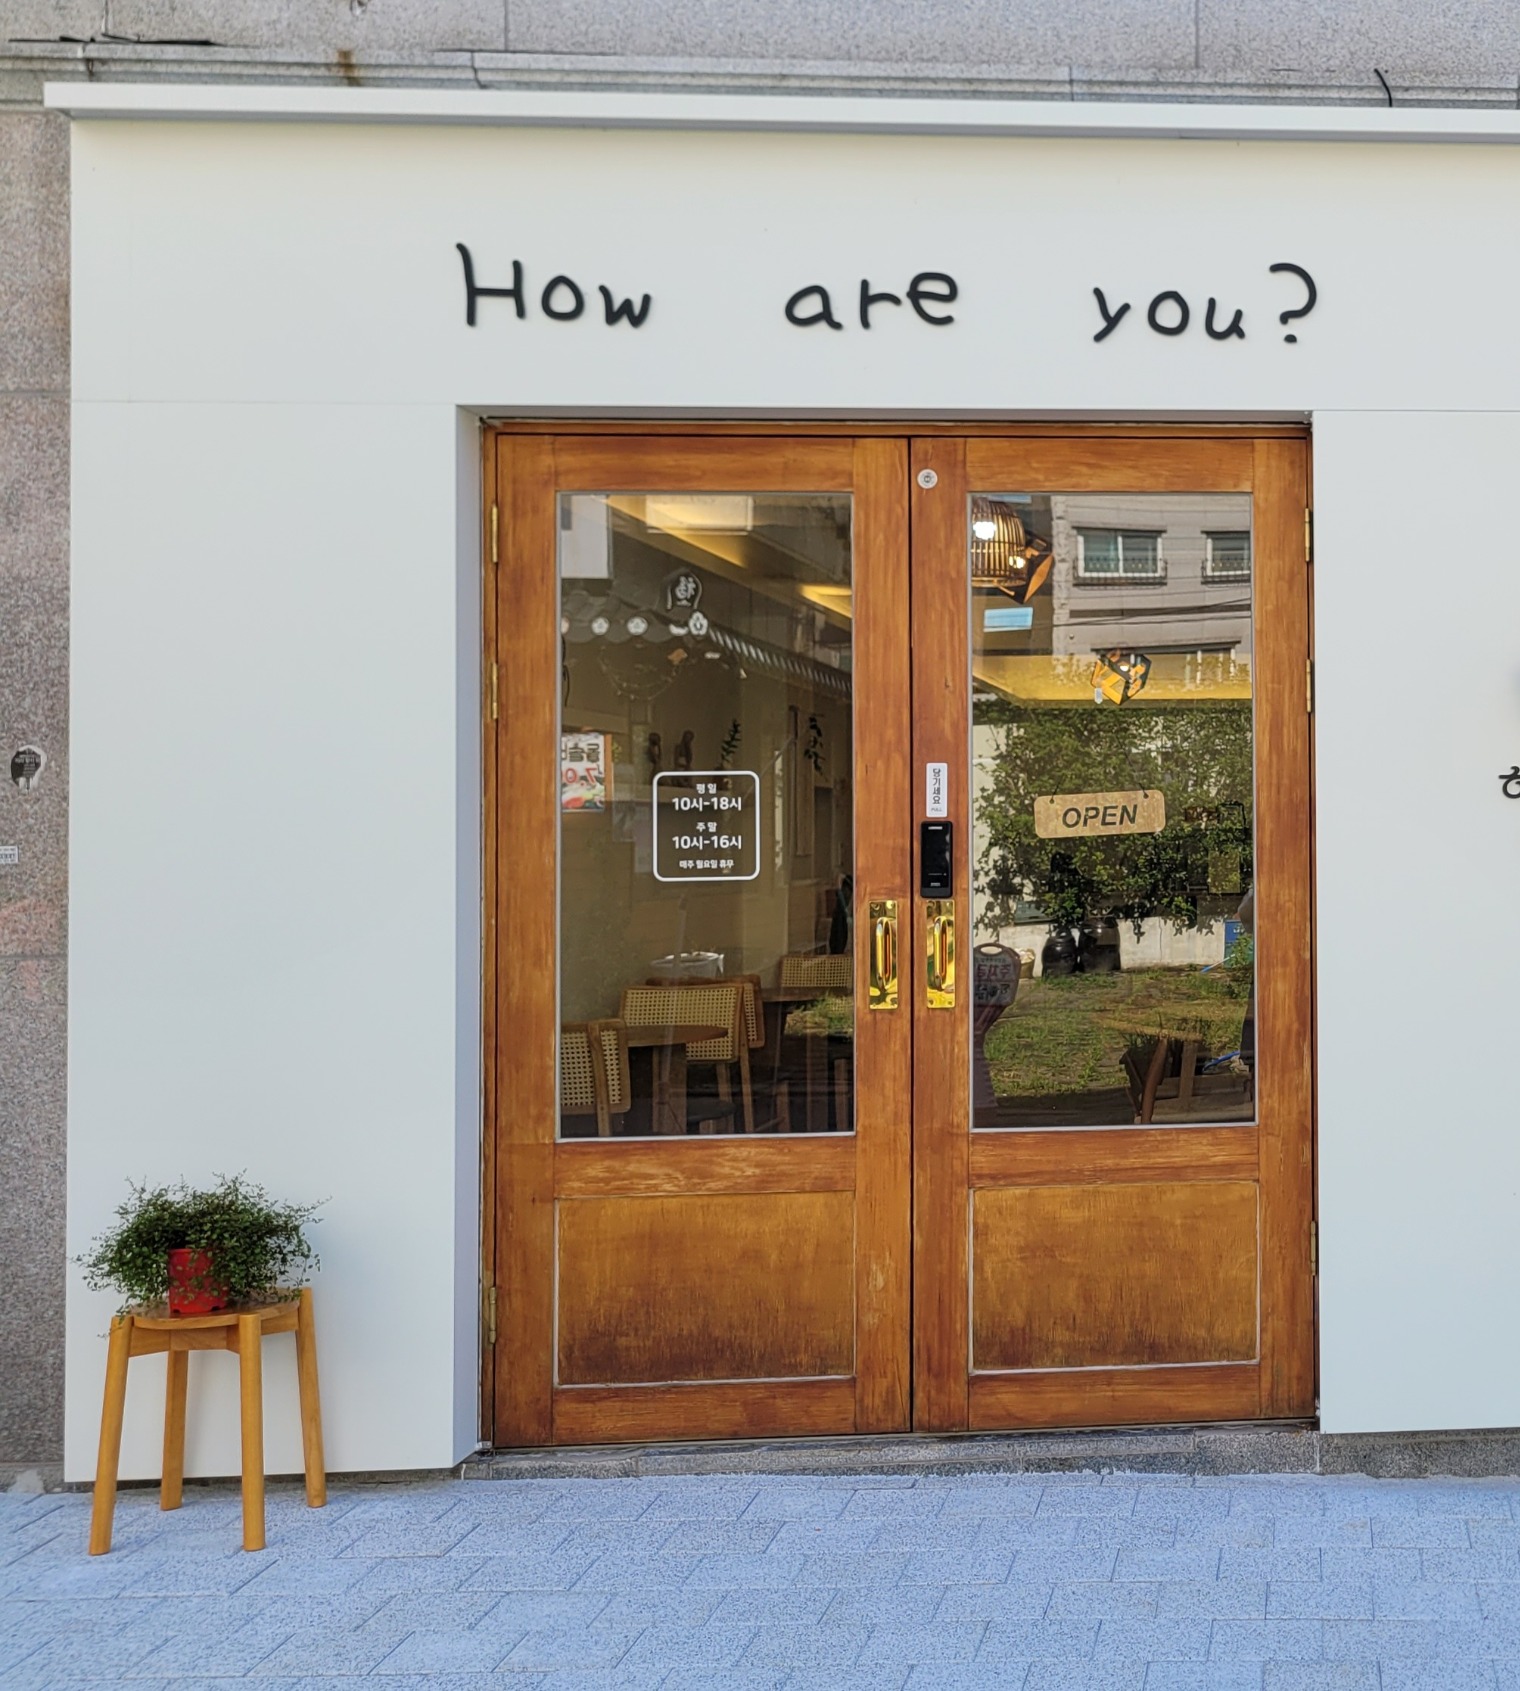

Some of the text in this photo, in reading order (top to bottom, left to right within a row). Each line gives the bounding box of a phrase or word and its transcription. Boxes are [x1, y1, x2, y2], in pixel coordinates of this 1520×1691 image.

[455, 242, 1318, 344] How are you?
[932, 768, 942, 805] 당기세요
[672, 797, 742, 812] 10시-18시
[1061, 804, 1138, 829] OPEN
[696, 822, 717, 832] 주말
[672, 835, 742, 850] 10시-16시
[679, 860, 695, 869] 매주
[719, 859, 734, 869] 휴무
